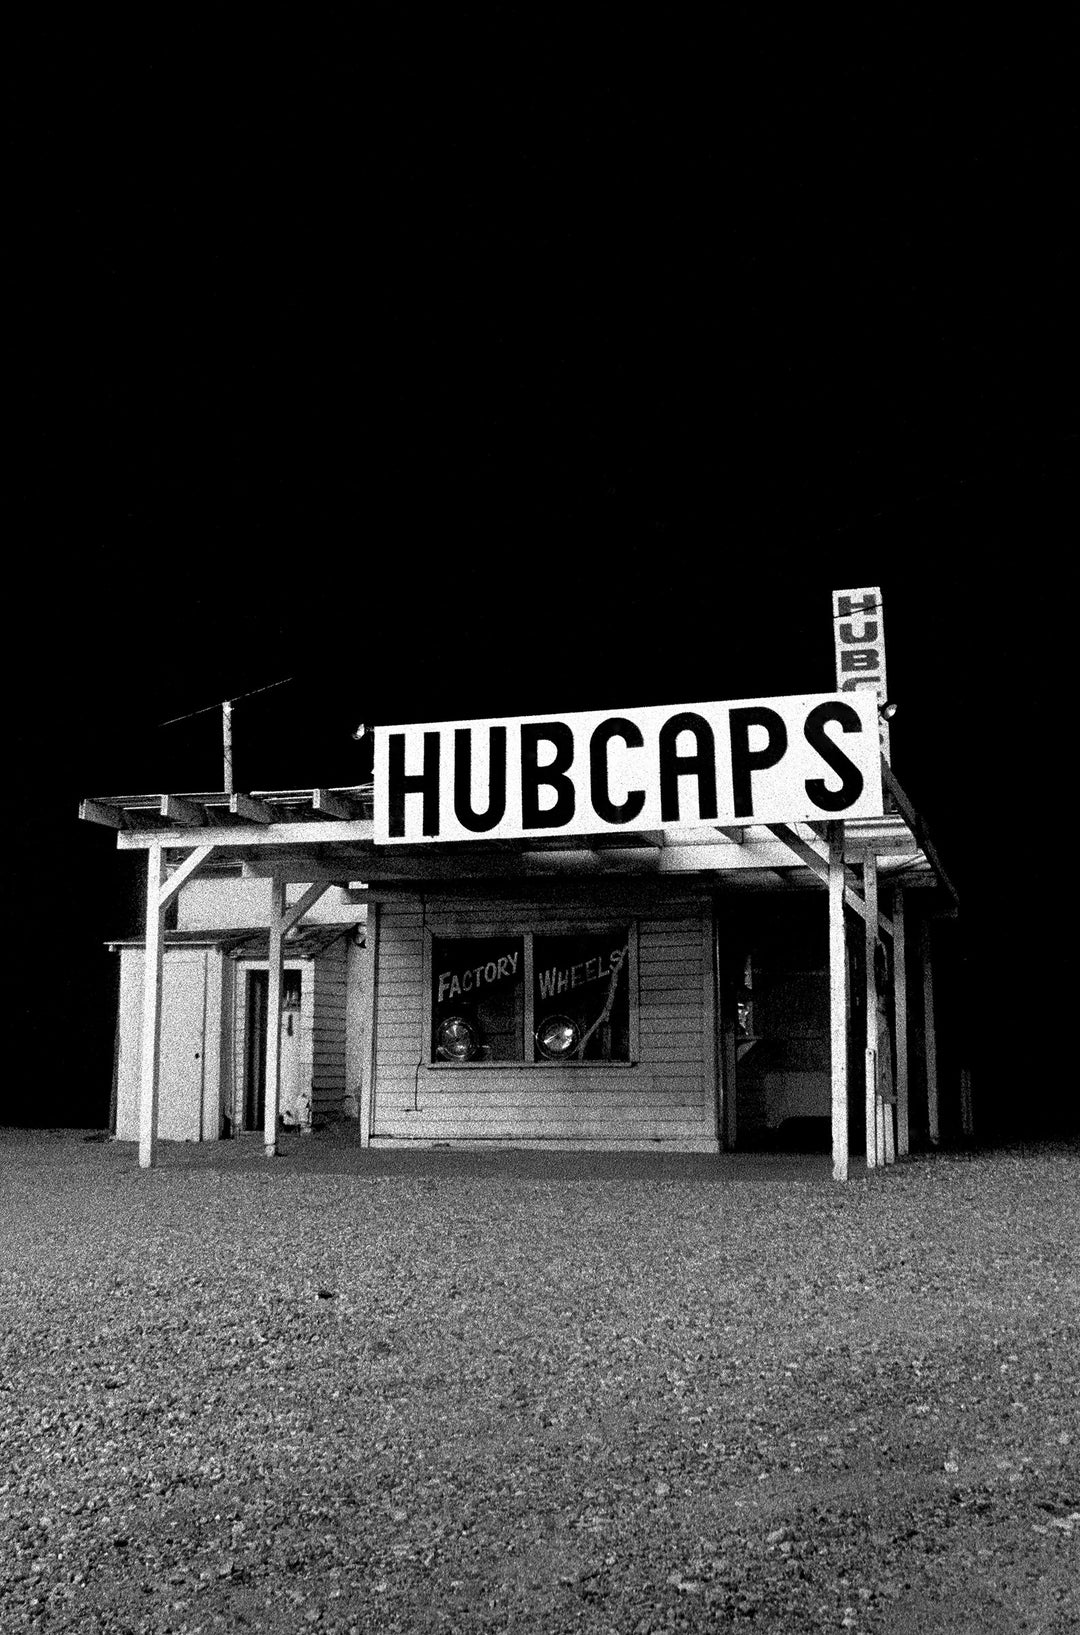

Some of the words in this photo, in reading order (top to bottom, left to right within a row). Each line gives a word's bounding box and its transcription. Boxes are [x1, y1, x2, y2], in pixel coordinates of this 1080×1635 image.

[838, 594, 881, 697] HUBC
[388, 700, 864, 838] HUBCAPS
[438, 951, 518, 1002] FACTORY
[538, 949, 624, 999] WHEELS
